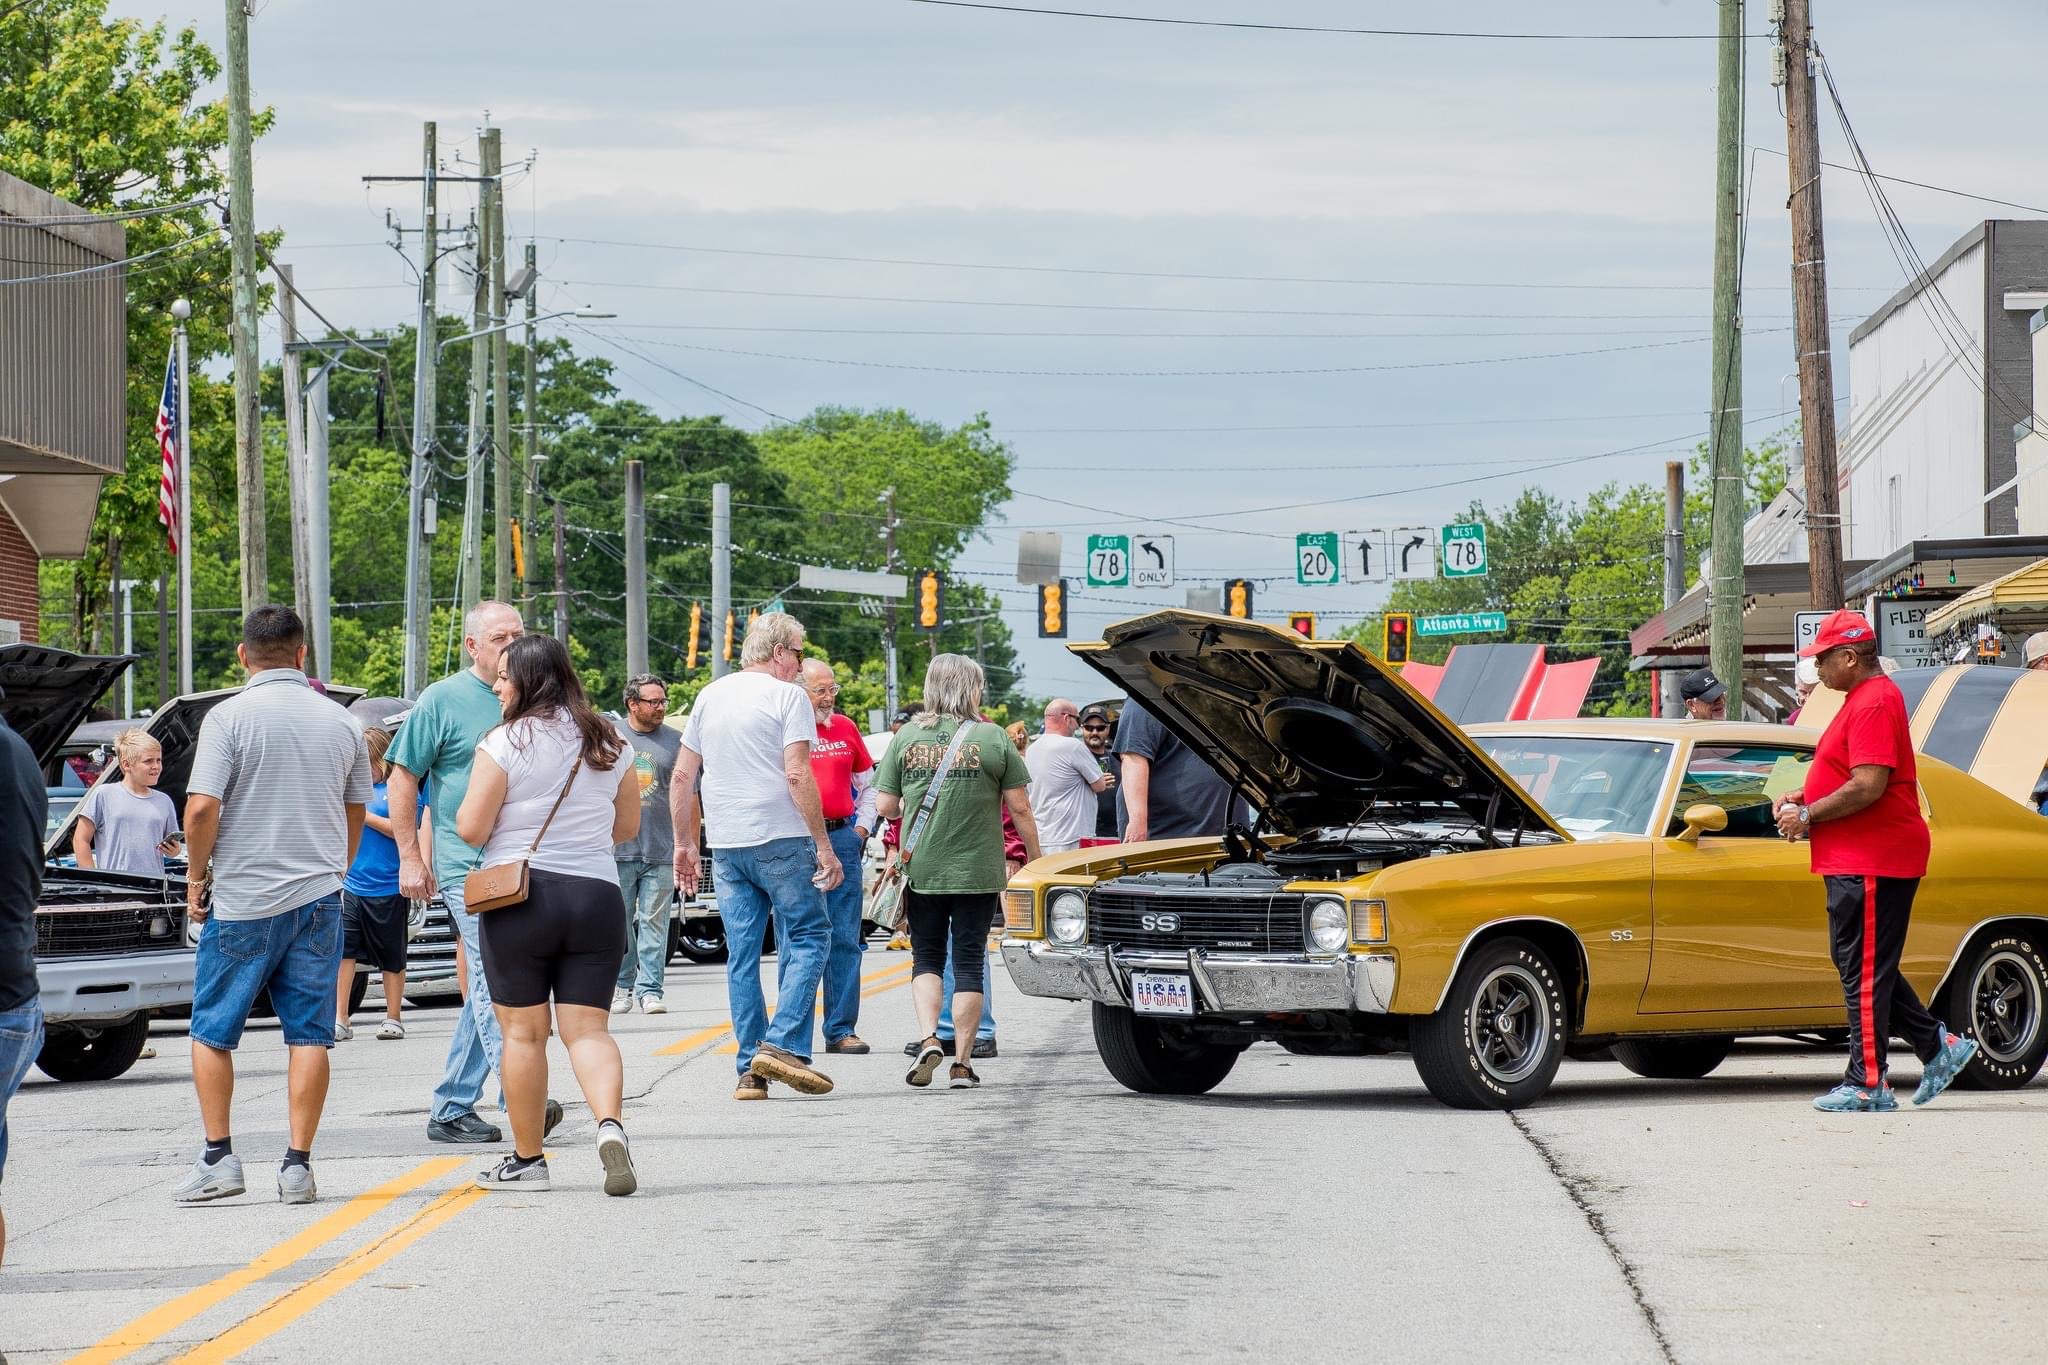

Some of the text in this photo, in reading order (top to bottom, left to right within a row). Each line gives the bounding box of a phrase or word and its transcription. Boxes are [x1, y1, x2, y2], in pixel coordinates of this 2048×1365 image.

[1451, 527, 1474, 537] WEST
[1098, 537, 1118, 547] EAST
[1306, 536, 1327, 546] EAST
[1452, 542, 1476, 566] 78
[1096, 553, 1119, 577] 78
[1303, 552, 1327, 576] 20
[1138, 572, 1167, 582] ONLY
[1423, 614, 1500, 632] Atlanta Hwy
[931, 769, 981, 779] SERIFF
[1142, 914, 1179, 932] SS
[1611, 929, 1633, 941] SS
